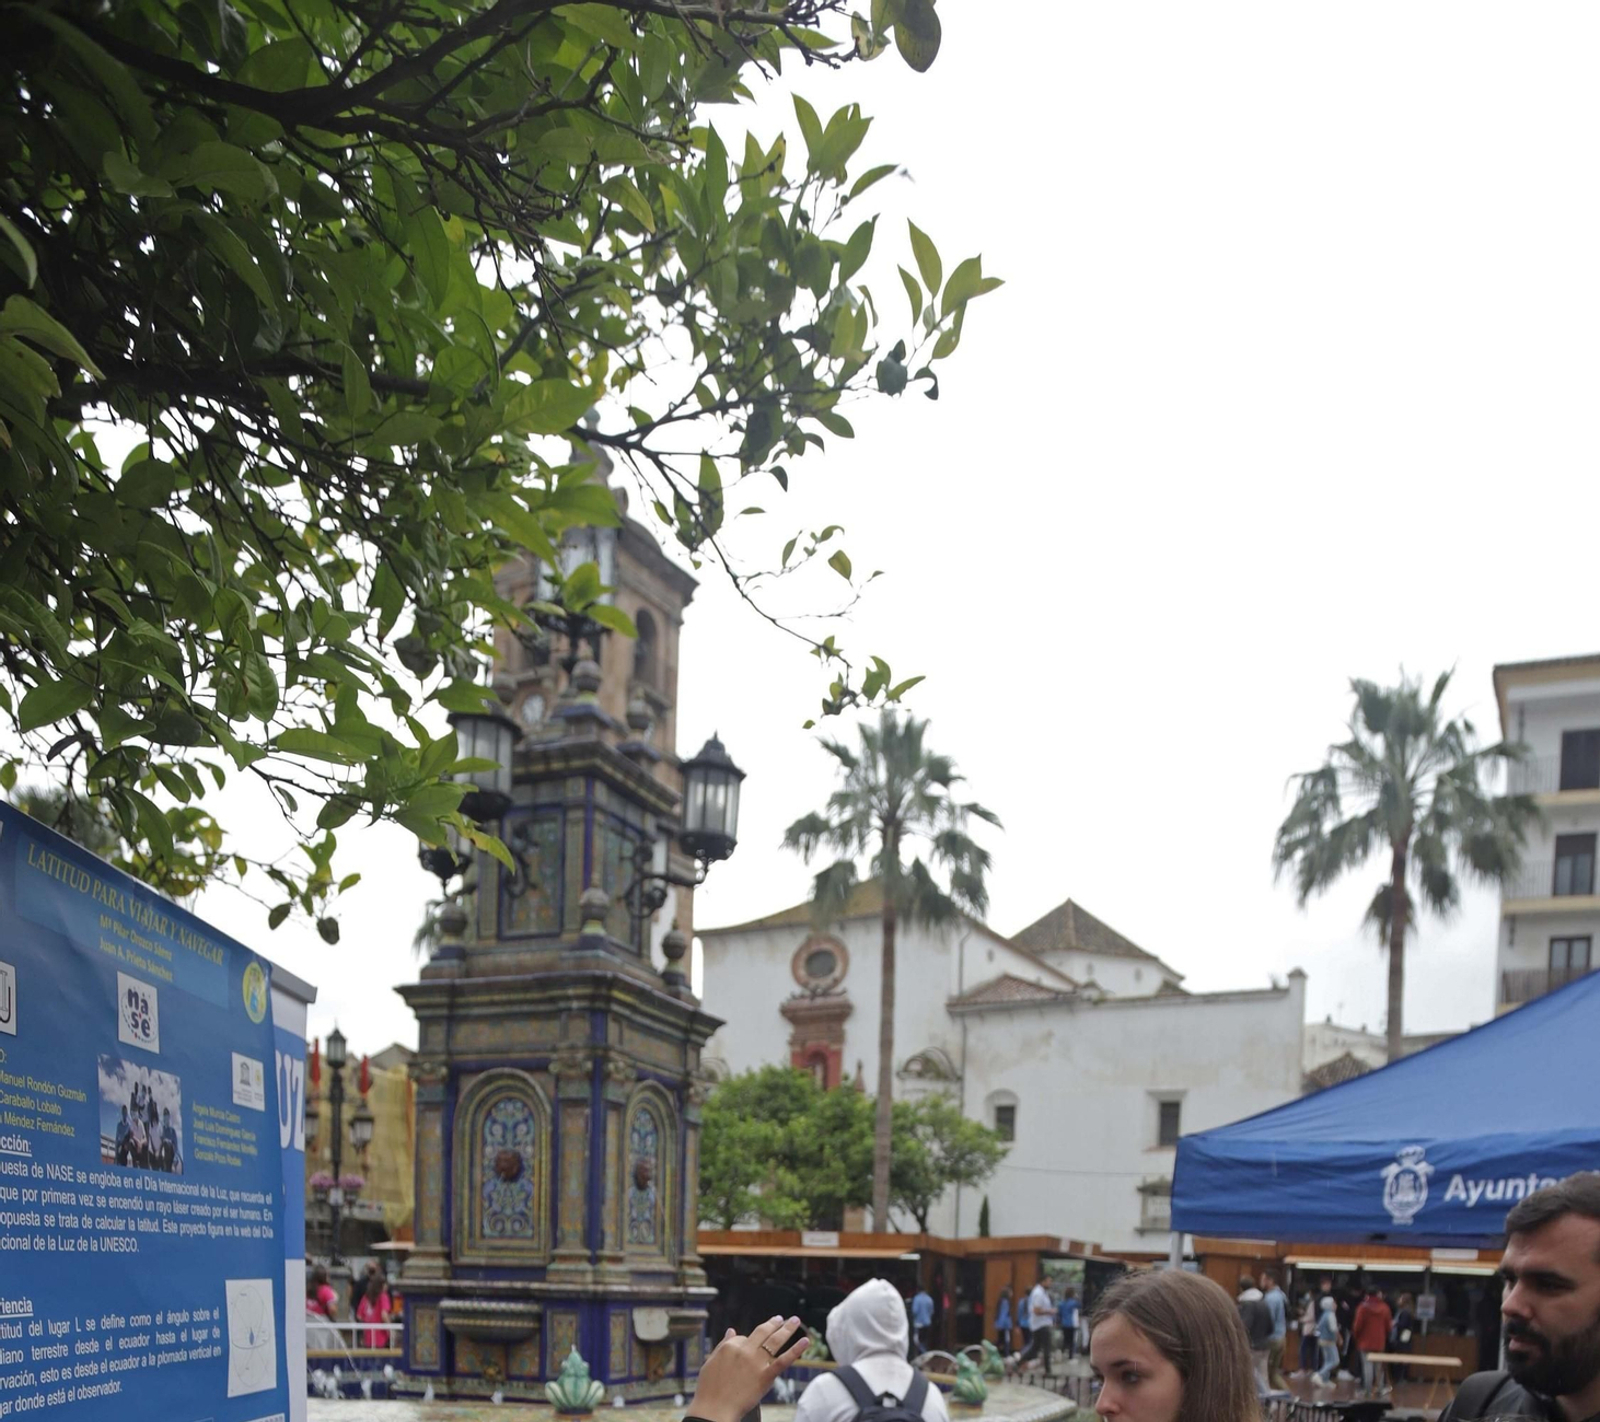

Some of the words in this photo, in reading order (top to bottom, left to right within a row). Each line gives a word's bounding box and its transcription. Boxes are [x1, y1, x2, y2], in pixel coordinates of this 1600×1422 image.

[27, 843, 91, 893] LATITUD
[92, 879, 125, 915] PARA
[129, 898, 168, 937] VIAJAR
[169, 921, 177, 940] Y
[177, 928, 224, 966] NAVEGAR
[100, 936, 116, 956] Juan
[26, 1076, 57, 1095] Rondón
[57, 1084, 87, 1103] Guzmán
[4, 1111, 35, 1129] Méndez
[36, 1118, 75, 1137] Fernández
[36, 1099, 62, 1117] Lobato
[0, 1161, 28, 1177] uesta
[31, 1162, 44, 1179] de
[46, 1163, 75, 1182] NASE
[76, 1170, 88, 1184] se
[89, 1171, 122, 1190] engloba
[123, 1177, 134, 1189] en
[135, 1175, 143, 1190] el
[158, 1179, 200, 1197] Internacional
[200, 1184, 209, 1198] de
[209, 1185, 216, 1199] la
[229, 1190, 240, 1203] que
[265, 1192, 273, 1205] el
[0, 1186, 19, 1204] que
[22, 1188, 38, 1205] por
[41, 1187, 76, 1207] primera
[78, 1193, 95, 1207] vez
[95, 1195, 107, 1208] se
[108, 1196, 144, 1211] encendió
[144, 1200, 155, 1212] un
[156, 1201, 172, 1216] rayo
[173, 1199, 190, 1215] láser
[190, 1203, 211, 1217] creado
[212, 1205, 222, 1220] por
[222, 1205, 229, 1218] el
[229, 1208, 240, 1220] ser
[263, 1208, 273, 1222] En
[0, 1210, 40, 1229] opuesta
[43, 1214, 56, 1228] se
[58, 1212, 79, 1229] trata
[81, 1213, 93, 1230] de
[95, 1215, 126, 1231] calcular
[127, 1216, 136, 1232] la
[137, 1217, 161, 1233] latitud.
[162, 1219, 178, 1234] Este
[179, 1221, 207, 1238] proyecto
[207, 1221, 224, 1239] figura
[224, 1224, 233, 1237] en
[233, 1224, 240, 1237] la
[252, 1225, 261, 1238] del
[0, 1233, 31, 1251] cional
[33, 1234, 46, 1251] de
[47, 1234, 57, 1251] la
[58, 1234, 75, 1251] Luz
[77, 1235, 89, 1252] de
[90, 1235, 99, 1252] la
[100, 1236, 140, 1253] UNESCO.
[0, 1321, 23, 1339] titud
[28, 1319, 44, 1337] del
[47, 1318, 71, 1338] lugar
[75, 1316, 82, 1333] L
[85, 1318, 96, 1332] se
[100, 1313, 125, 1330] define
[129, 1314, 151, 1328] como
[155, 1310, 163, 1325] el
[166, 1309, 190, 1327] ángulo
[192, 1307, 210, 1322] sobre
[213, 1306, 220, 1320] el
[31, 1342, 69, 1361] terrestre
[74, 1337, 99, 1355] desde
[105, 1336, 113, 1351] el
[118, 1333, 150, 1350] ecuador
[155, 1331, 176, 1346] hasta
[180, 1328, 188, 1343] el
[191, 1327, 209, 1344] lugar
[212, 1325, 221, 1339] de
[40, 1366, 60, 1384] esto
[61, 1367, 72, 1380] es
[74, 1360, 99, 1378] desde
[100, 1358, 108, 1374] el
[109, 1354, 140, 1372] ecuador
[141, 1357, 147, 1368] a
[148, 1351, 156, 1366] la
[157, 1349, 188, 1368] plomada
[189, 1345, 212, 1361] vertical
[213, 1346, 222, 1357] en
[14, 1392, 45, 1412] donde
[47, 1387, 66, 1406] está
[67, 1386, 76, 1402] el
[77, 1379, 122, 1401] observador.
